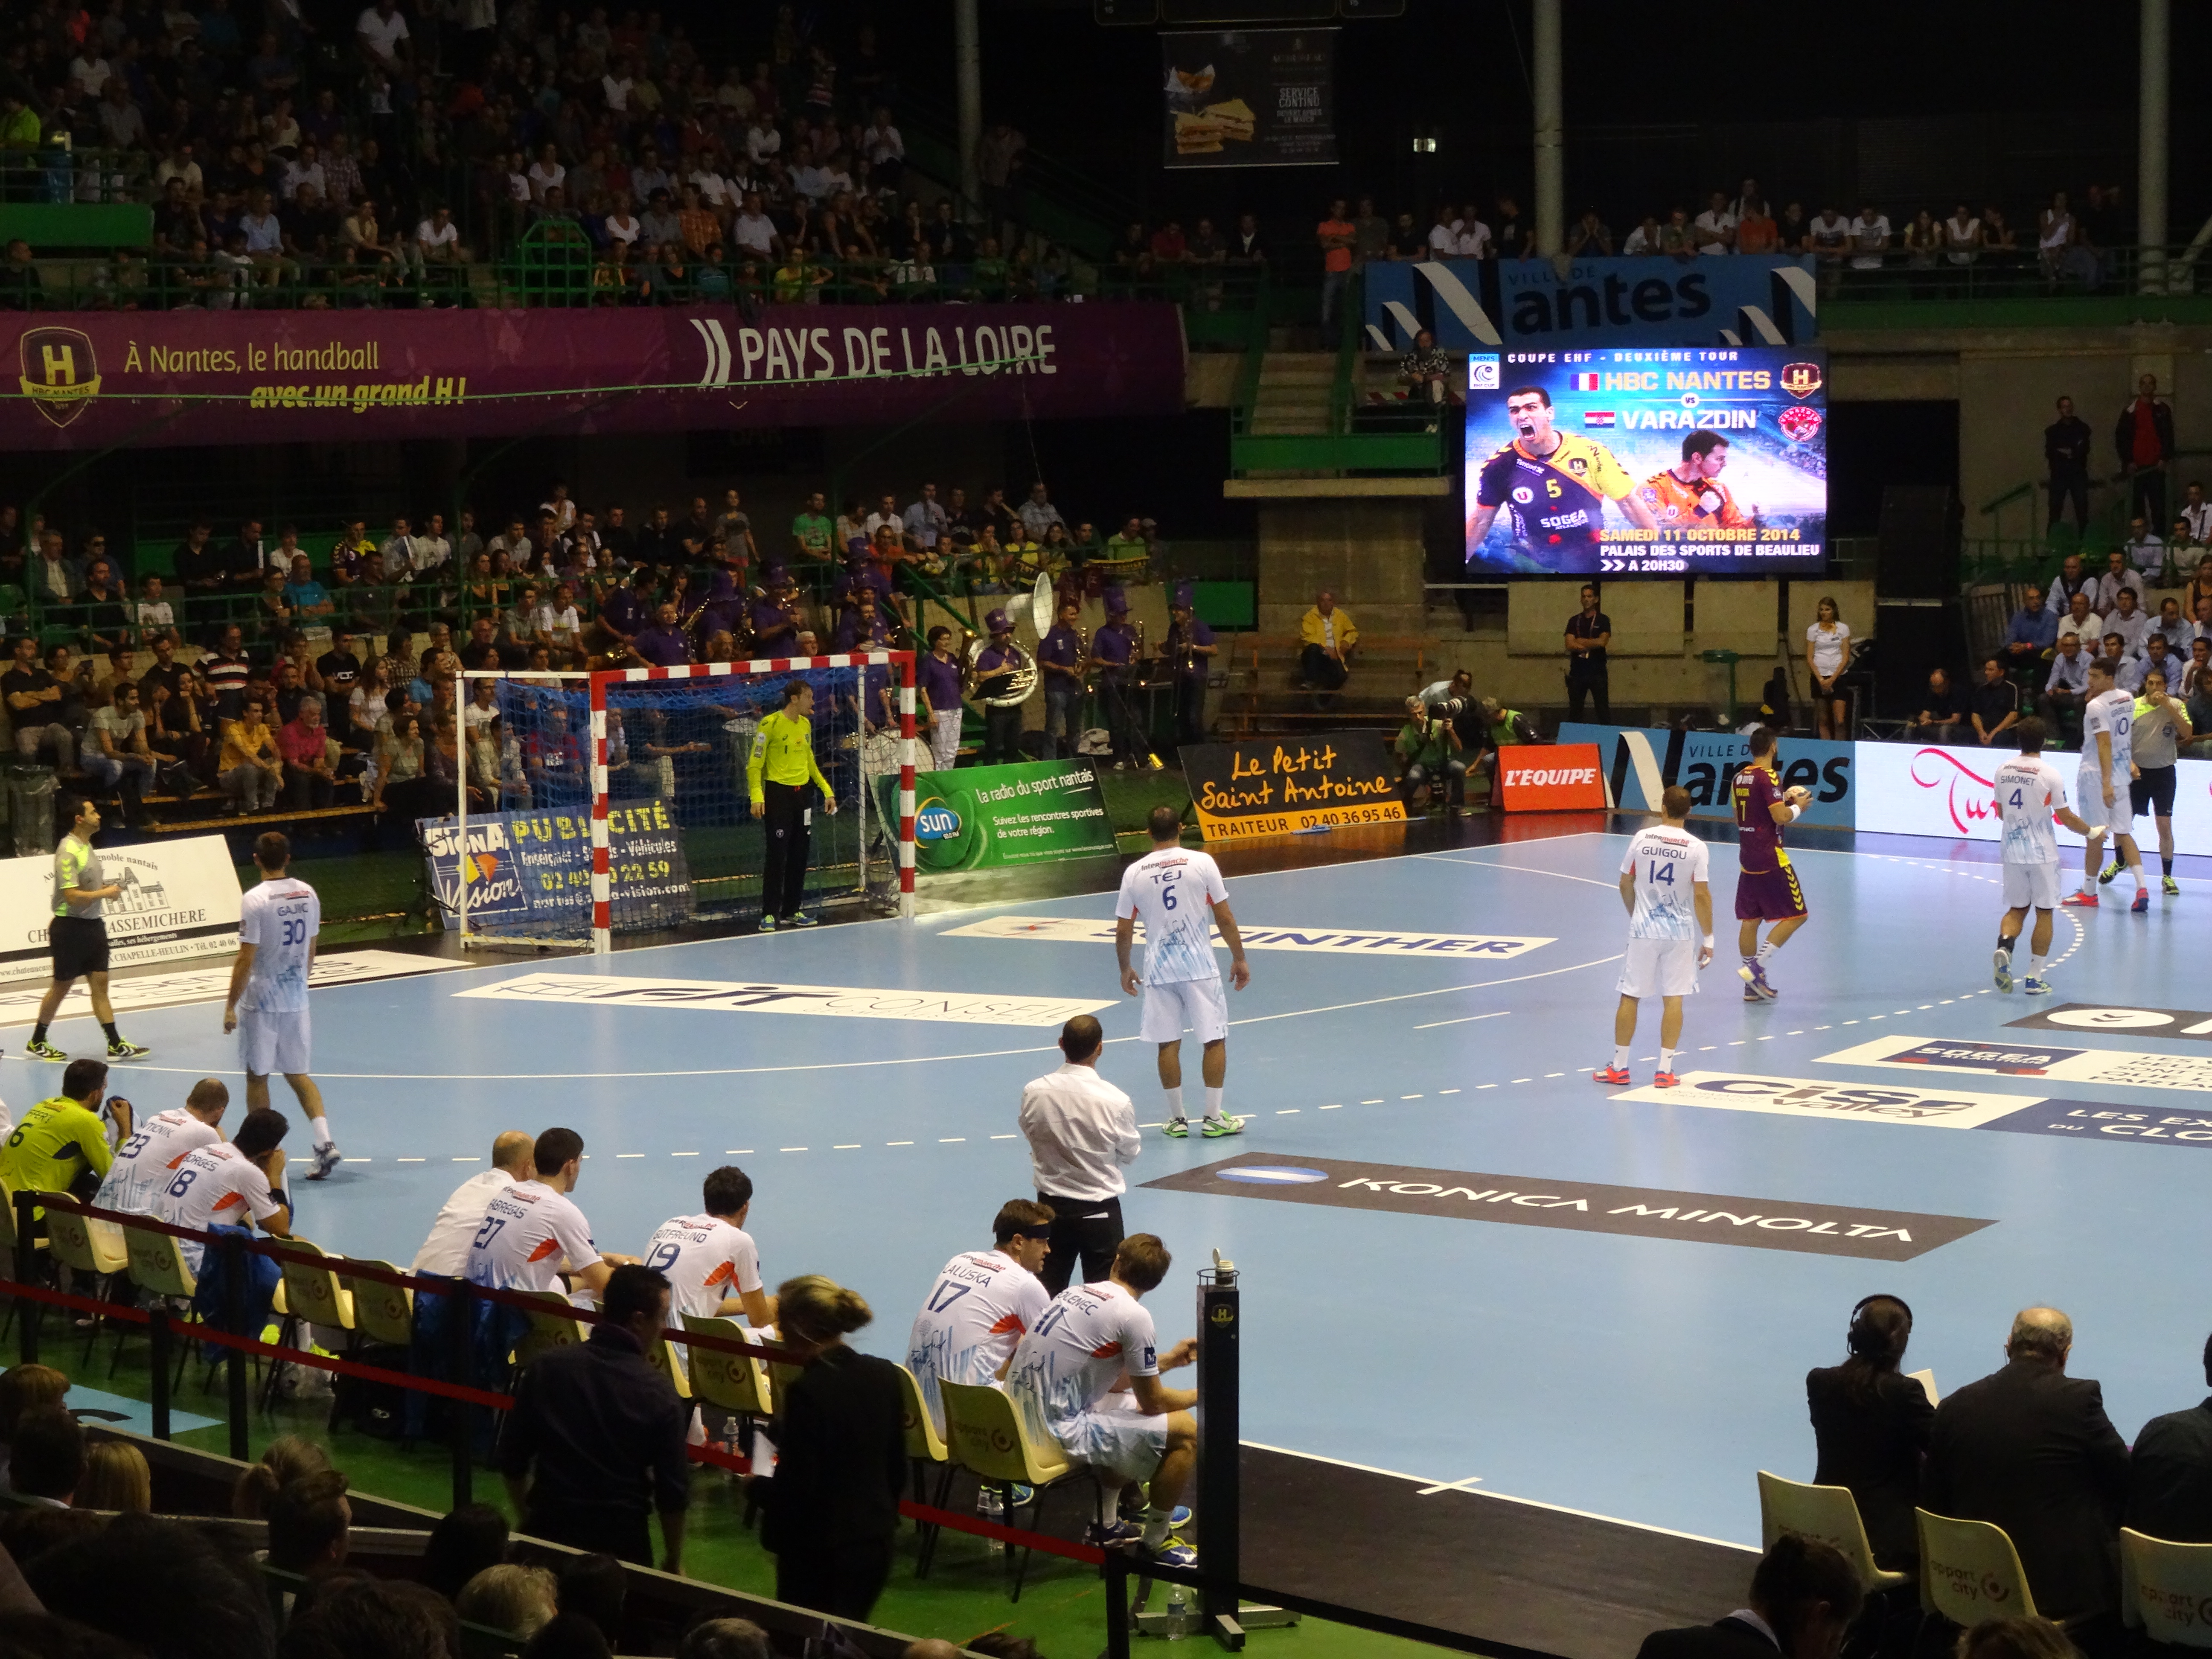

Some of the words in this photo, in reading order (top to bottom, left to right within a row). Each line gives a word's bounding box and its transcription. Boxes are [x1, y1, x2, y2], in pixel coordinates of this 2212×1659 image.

[1279, 98, 1320, 108] CONTINU
[1280, 87, 1318, 98] SERVICE
[124, 341, 142, 373] À
[151, 344, 241, 375] Nantes,
[248, 342, 267, 370] le
[273, 341, 379, 371] handball
[739, 328, 835, 379] PAYS
[843, 327, 893, 377] DE
[901, 327, 951, 377] LA
[956, 325, 1057, 375] LOIRE
[1508, 353, 1556, 363] COUPE
[1564, 353, 1592, 363] EHF
[1614, 349, 1695, 362] DEUXIÈME
[1699, 351, 1738, 361] TOUR
[42, 345, 76, 384] H
[1605, 372, 1659, 390] HBC
[1667, 371, 1771, 390] NANTES
[1793, 369, 1809, 384] H
[250, 382, 310, 408] avec
[314, 381, 349, 407] un
[352, 376, 429, 414] grand
[1622, 409, 1757, 429] VARAZDIN
[1517, 492, 1528, 500] U
[1545, 478, 1562, 498] 5
[1540, 509, 1588, 528] SOGEA
[1600, 529, 1659, 542] SAMEDI
[1664, 529, 1679, 541] 11
[1687, 528, 1757, 541] OCTOBRE
[1761, 528, 1800, 541] 2014
[1600, 545, 1647, 557] PALAIS
[1650, 544, 1675, 556] DES
[1679, 544, 1731, 556] SPORTS
[1735, 544, 1752, 556] DE
[1755, 544, 1819, 556] BEAULIEU
[1627, 560, 1639, 571] A
[1641, 560, 1685, 571] 20H30
[1689, 744, 1735, 758] VILLE
[1231, 751, 1266, 781] Le
[1272, 744, 1337, 774] Petit
[975, 788, 989, 803] la
[990, 783, 1015, 801] radio
[1017, 780, 1030, 796] du
[1030, 776, 1059, 797] sport
[1058, 768, 1094, 789] nantais
[2000, 775, 2036, 786] SIMONET
[1201, 781, 1274, 810] Saint
[1284, 774, 1392, 803] Antoine
[2008, 788, 2024, 809] 4
[992, 815, 1016, 826] Suivez
[1017, 812, 1030, 824] les
[1030, 810, 1070, 823] rencontres
[1071, 807, 1104, 821] sportives
[1740, 800, 1746, 822] 7
[511, 800, 671, 845] PUBLCITÉ
[920, 812, 953, 832] sun
[996, 828, 1007, 838] de
[1007, 827, 1028, 838] votre
[1029, 825, 1055, 837] région.
[1206, 818, 1289, 838] TRAITEUR
[1301, 815, 1317, 829] 02
[1322, 814, 1339, 826] 40
[1341, 811, 1360, 824] 36
[1363, 809, 1381, 822] 95
[1383, 806, 1401, 820] 46
[626, 837, 677, 857] Véhicules
[1642, 846, 1687, 860] GUIGOU
[126, 855, 159, 871] nantais
[1649, 860, 1675, 886] 14
[541, 873, 564, 890] 02
[620, 863, 642, 882] 22
[647, 859, 670, 878] 59
[1150, 870, 1182, 885] TEJ
[446, 878, 521, 909] Vision
[1162, 885, 1177, 910] 6
[108, 908, 207, 934] ASSEMICHERE
[282, 919, 306, 946] 30
[115, 945, 189, 962] CHAPELLE-HEULIN
[195, 941, 207, 952] Tél.
[208, 941, 218, 950] 02
[218, 939, 227, 949] 40
[228, 937, 236, 947] 06
[826, 996, 1084, 1019] CONSEIL
[1915, 1048, 2052, 1065] SOGEA
[2088, 1076, 2212, 1088] PARTA
[2101, 1071, 2182, 1079] QUE
[1773, 1097, 1951, 1119] valley
[2066, 1109, 2149, 1121] LES
[9, 1122, 34, 1148] 6
[118, 1133, 151, 1159] 23
[164, 1167, 197, 1198] 18
[1337, 1176, 1588, 1213] KONICA
[1607, 1203, 1915, 1243] MINOLTA
[474, 1216, 506, 1249] 27
[645, 1242, 681, 1272] 19
[927, 1279, 972, 1313] 17
[1033, 1304, 1069, 1337] 11
[1952, 1581, 1978, 1601] city
